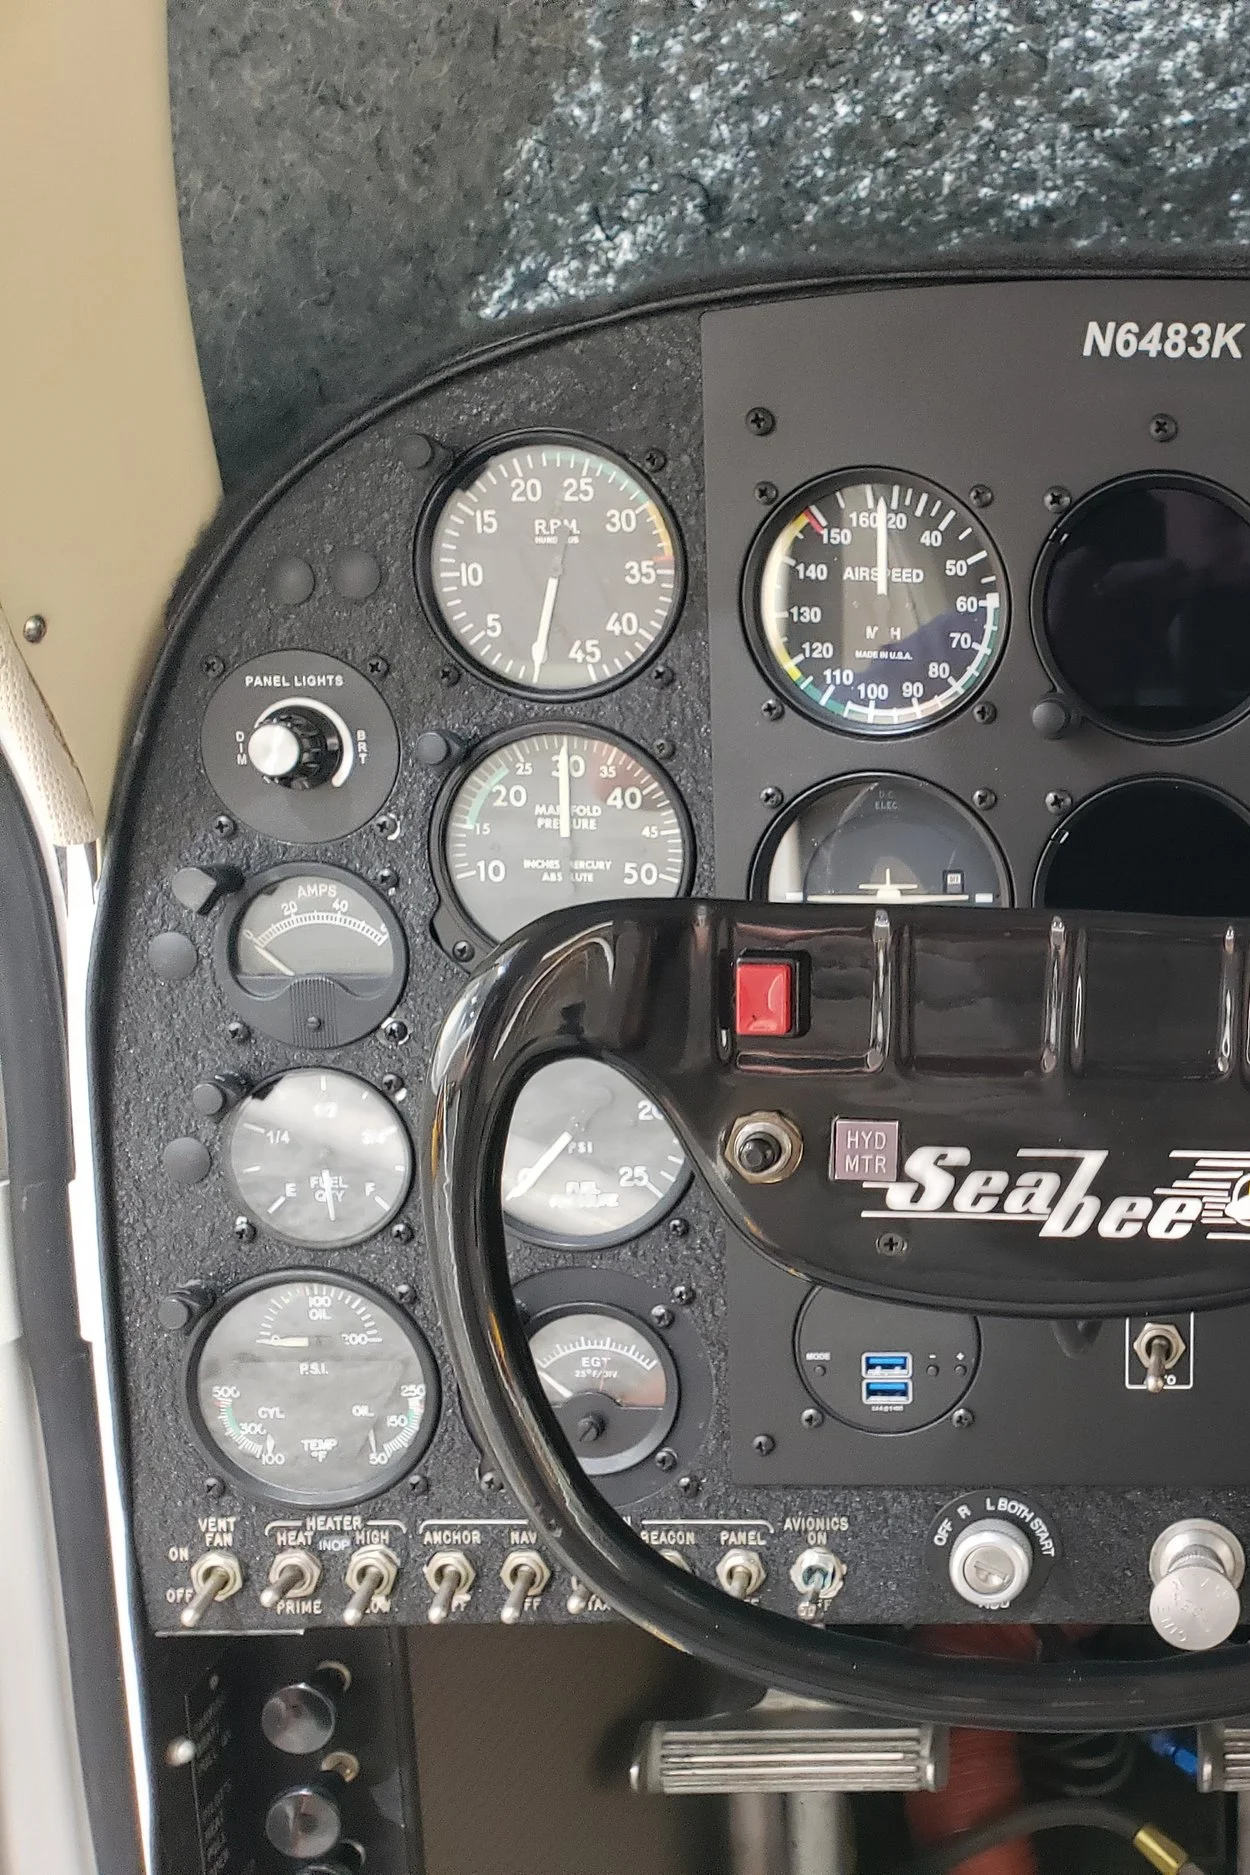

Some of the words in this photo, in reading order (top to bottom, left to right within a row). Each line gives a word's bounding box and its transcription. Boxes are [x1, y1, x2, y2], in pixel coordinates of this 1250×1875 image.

[1082, 321, 1246, 358] N6483K
[511, 478, 542, 502] 20
[563, 478, 594, 501] 25
[475, 510, 498, 534] 15
[605, 509, 637, 533] 30
[850, 512, 878, 529] 160
[887, 513, 907, 530] 20
[822, 528, 852, 545] 150
[920, 530, 942, 547] 40
[460, 562, 483, 586] 10
[624, 561, 656, 584] 35
[797, 564, 828, 581] 140
[945, 559, 968, 577] 50
[956, 596, 978, 613] 60
[790, 606, 821, 623] 130
[486, 613, 502, 638] 5
[606, 612, 638, 636] 40
[950, 632, 972, 649] 70
[569, 640, 601, 663] 45
[802, 642, 834, 659] 120
[855, 650, 878, 660] MADE
[879, 650, 888, 660] IN
[823, 668, 854, 686] 110
[928, 661, 950, 679] 80
[245, 676, 290, 687] PANEL
[294, 675, 344, 686] LIGHTS
[857, 683, 889, 700] 100
[901, 682, 924, 698] 90
[515, 763, 533, 775] 25
[600, 766, 616, 778] 35
[492, 785, 527, 807] 20
[606, 787, 642, 810] 40
[537, 818, 597, 830] PREURE
[642, 826, 659, 839] 45
[477, 860, 506, 882] 10
[523, 860, 560, 870] INCHES
[570, 860, 612, 871] ERCURY
[623, 863, 658, 885] 50
[297, 884, 337, 898] AMPS
[267, 1130, 290, 1144] 1/4
[845, 1129, 887, 1151] HYD
[845, 1153, 888, 1175] MTR
[285, 1183, 297, 1197] E
[365, 1182, 376, 1196] F
[885, 1145, 1204, 1239] Seabee
[582, 1357, 610, 1367] EGT
[301, 1439, 338, 1451] TEMP
[956, 1504, 972, 1519] R
[986, 1497, 995, 1511] L
[997, 1497, 1035, 1523] BOTH
[199, 1518, 236, 1532] VENT
[306, 1516, 364, 1530] HEATER
[783, 1517, 849, 1532] AVIONICS
[205, 1533, 232, 1547] FAN
[277, 1531, 314, 1545] HEAT
[356, 1531, 389, 1544] HIGH
[423, 1530, 481, 1545] ANCHOR
[510, 1532, 537, 1544] NAV
[720, 1531, 766, 1545] PANEL
[807, 1532, 827, 1545] ON
[934, 1518, 953, 1546] OFF
[1029, 1517, 1055, 1557] START
[319, 1538, 350, 1551] INOP
[169, 1548, 188, 1561] ON
[166, 1590, 194, 1603] OFF
[277, 1600, 322, 1614] PRIME
